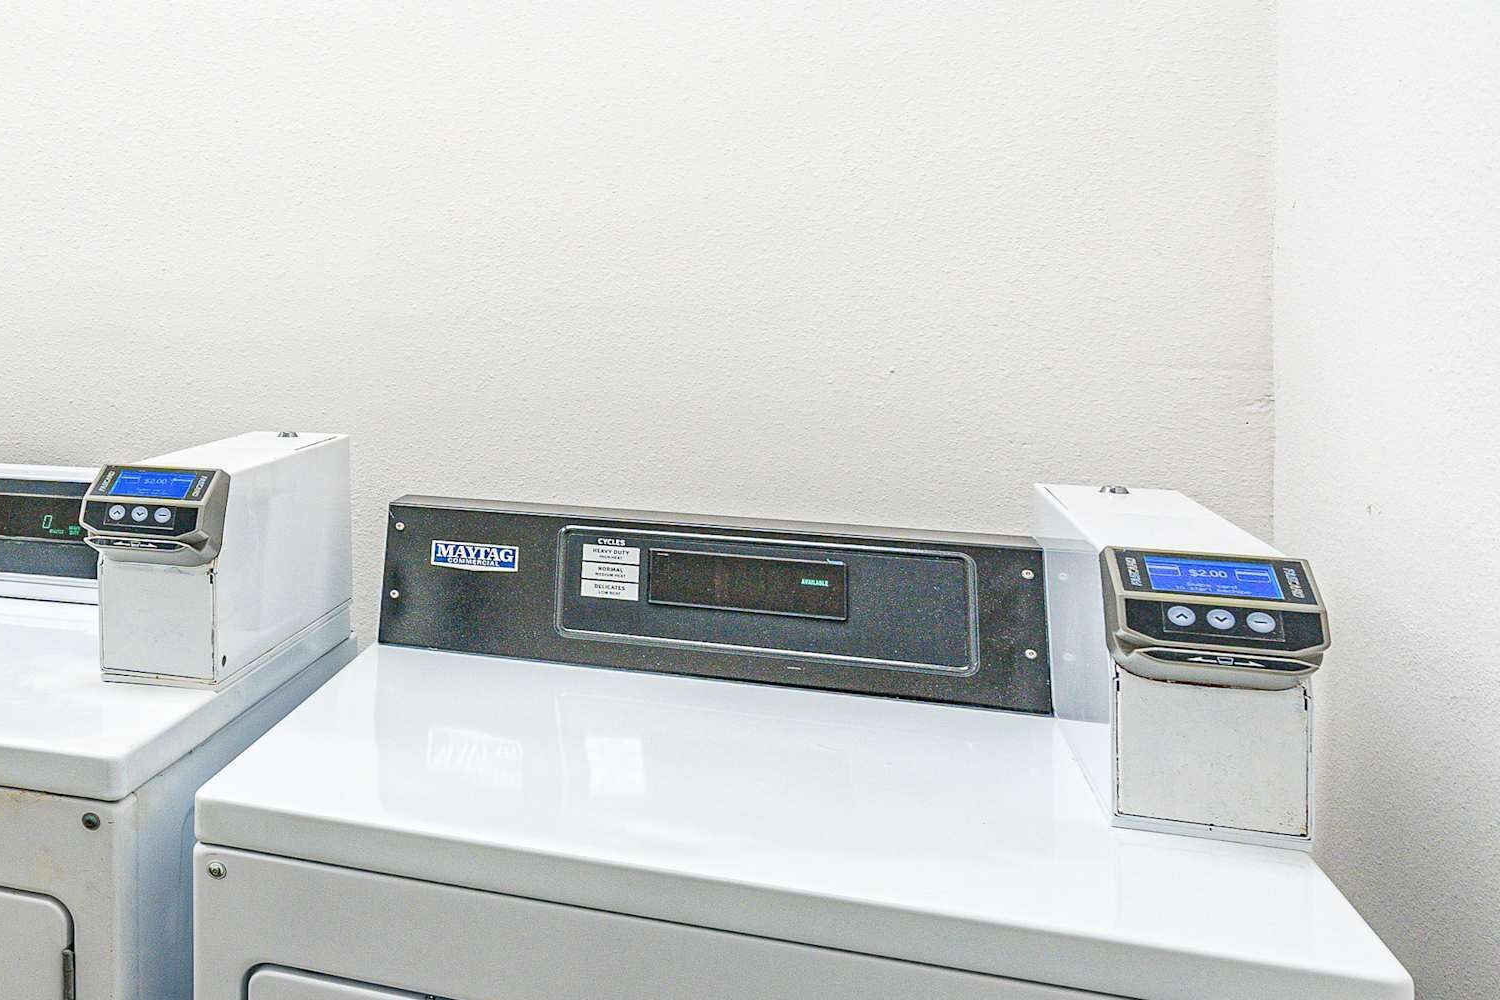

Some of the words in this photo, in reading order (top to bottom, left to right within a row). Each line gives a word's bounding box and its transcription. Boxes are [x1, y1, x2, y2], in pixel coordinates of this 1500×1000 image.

[597, 537, 626, 546] CYCLES
[436, 543, 514, 563] MAYTAG
[447, 557, 500, 567] COMMERCIAL
[1187, 568, 1229, 578] $2.00
[594, 583, 626, 591] DELICATES
[801, 578, 829, 587] AVAILABLE
